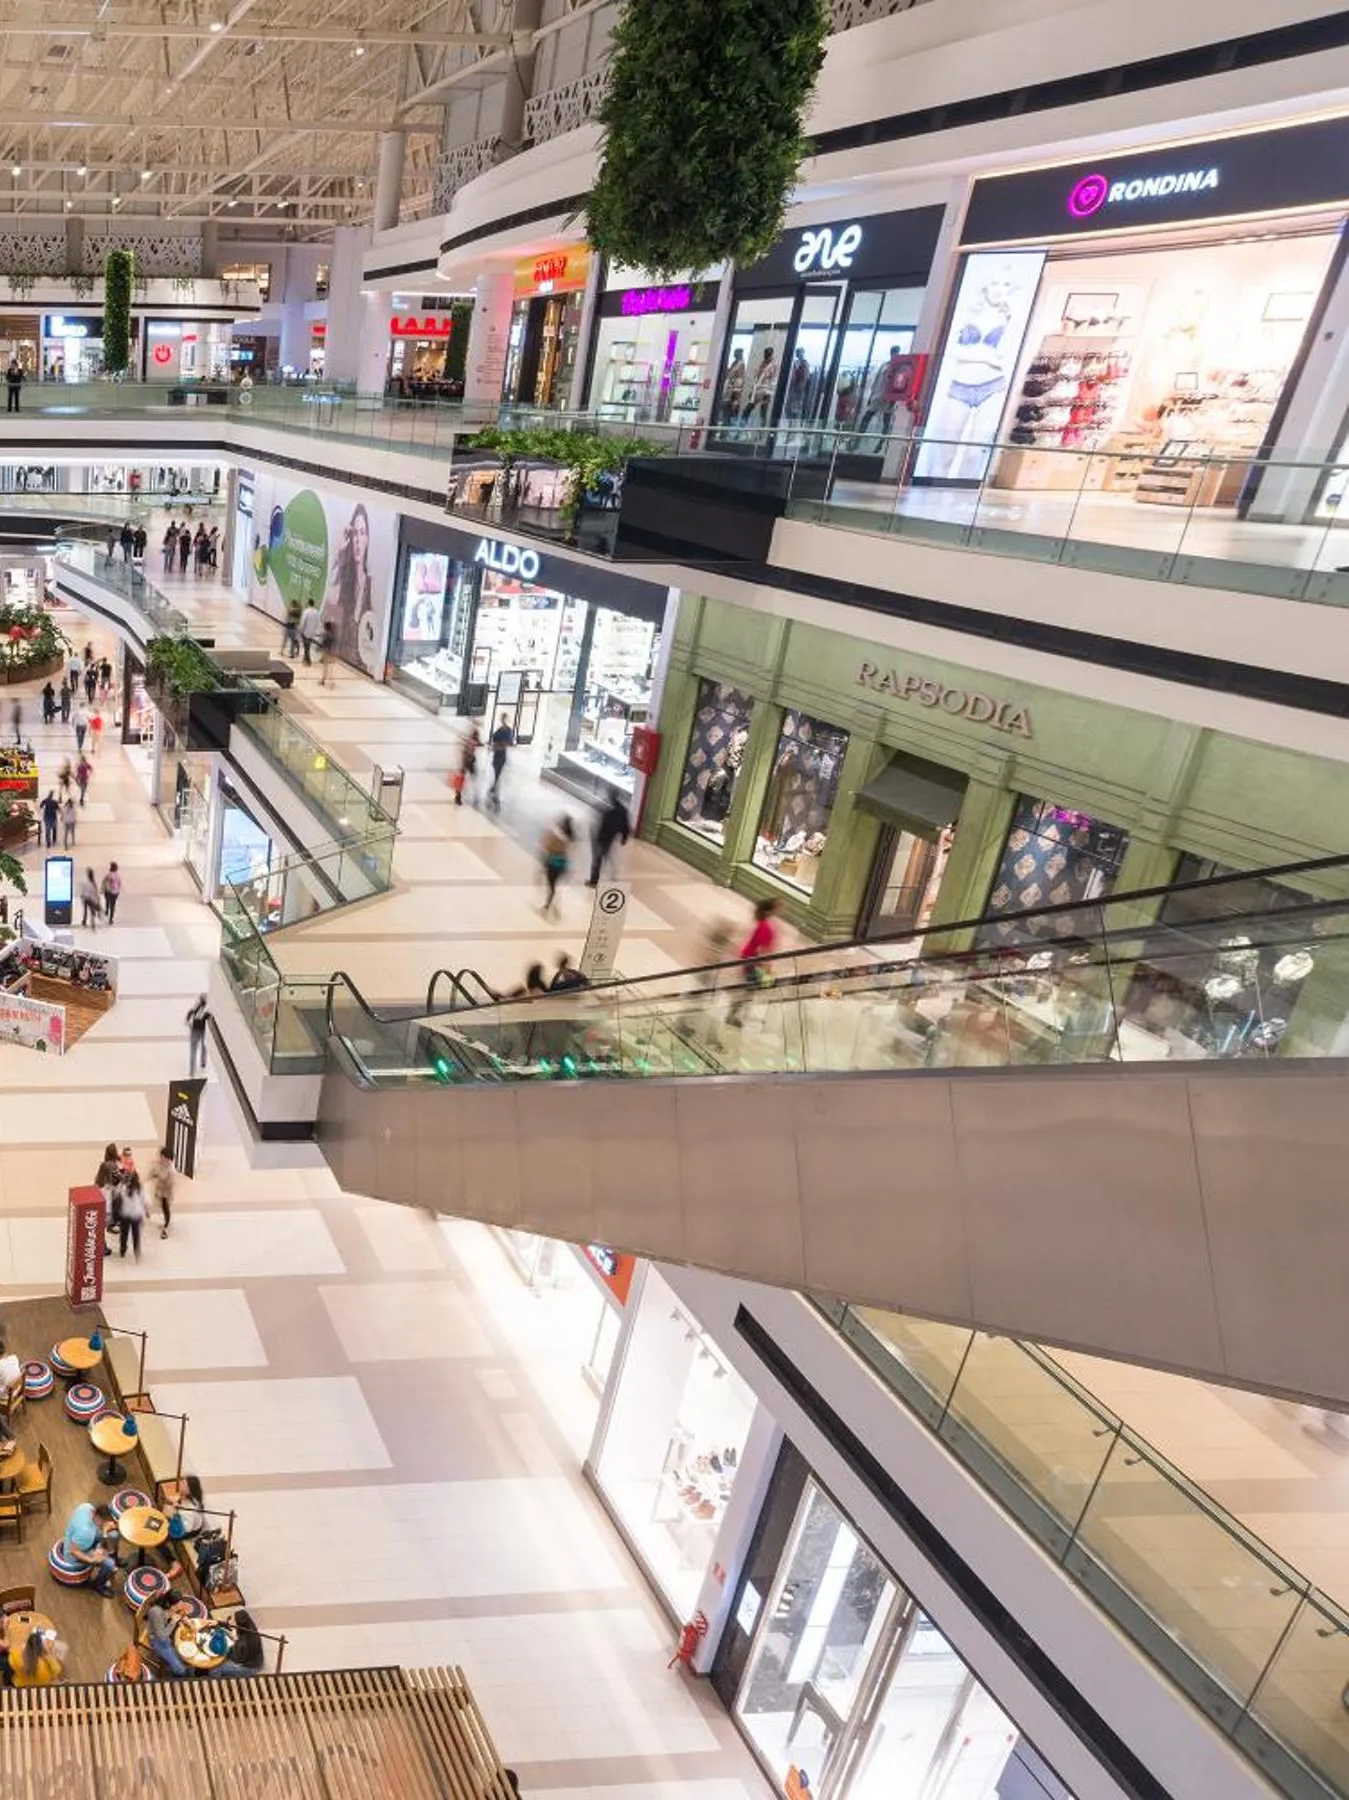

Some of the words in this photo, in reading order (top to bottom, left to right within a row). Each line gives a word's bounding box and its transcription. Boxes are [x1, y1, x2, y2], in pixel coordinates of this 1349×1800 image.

[1108, 168, 1219, 202] RONDINA
[474, 538, 539, 579] ALDO
[854, 658, 1034, 740] RAPSODIA
[605, 893, 620, 909] 2
